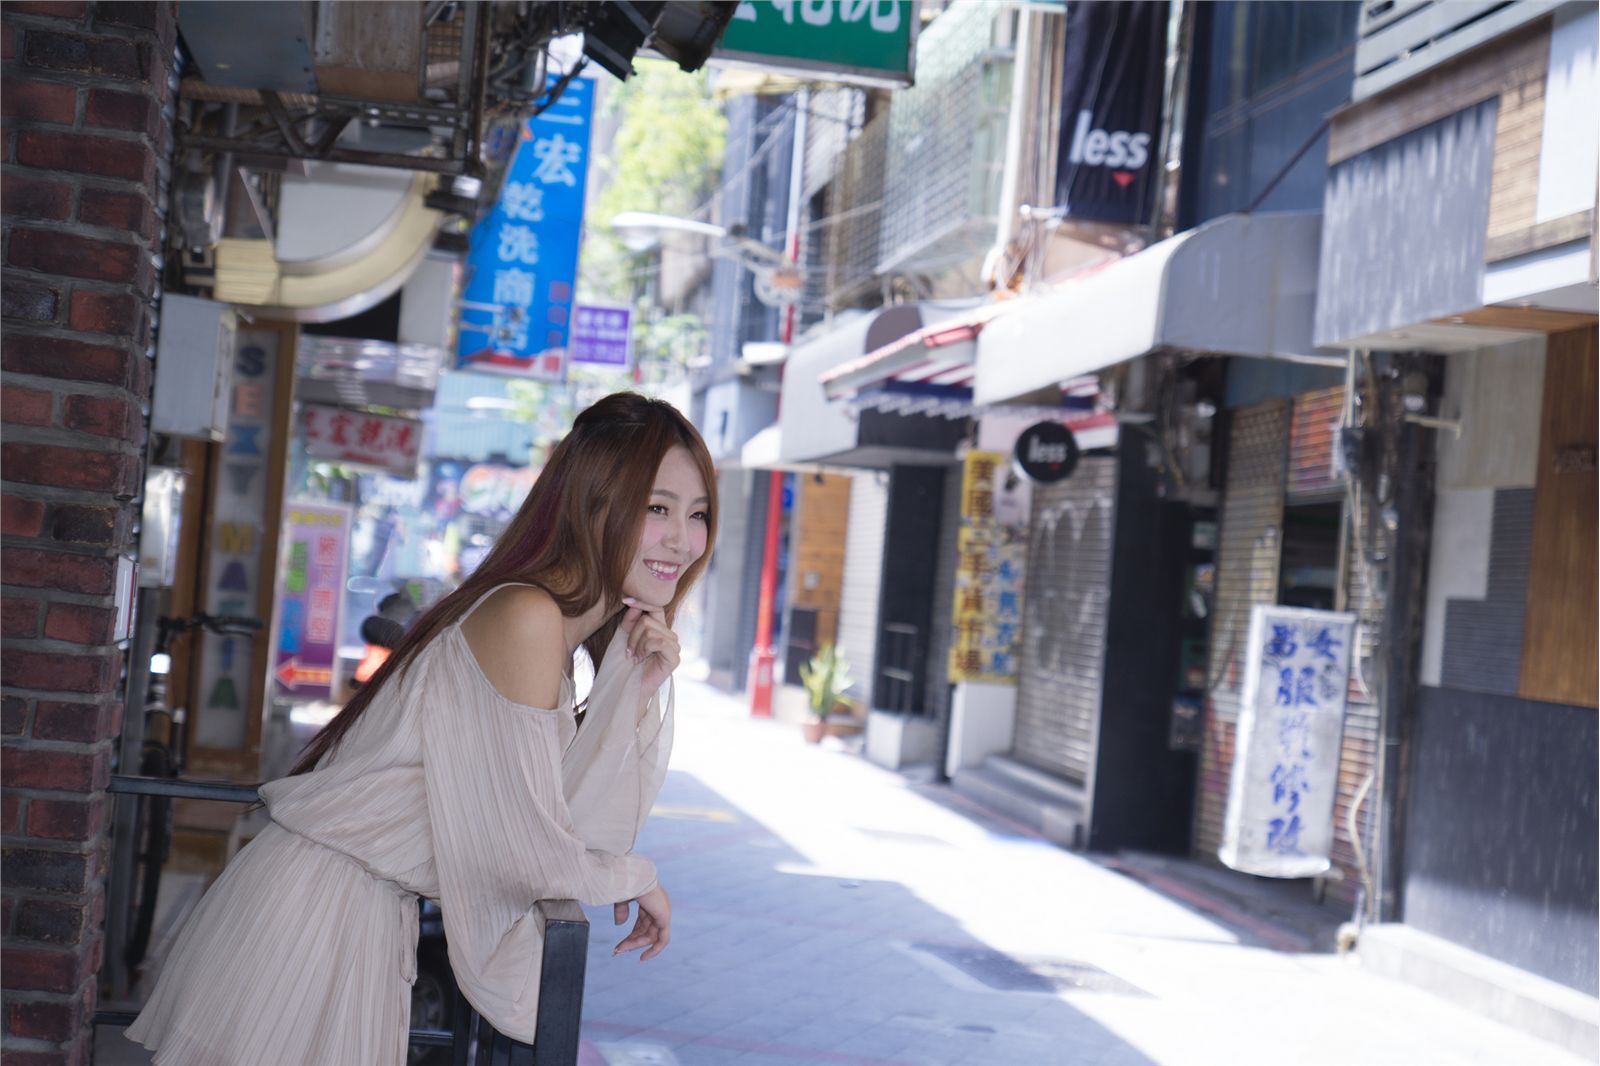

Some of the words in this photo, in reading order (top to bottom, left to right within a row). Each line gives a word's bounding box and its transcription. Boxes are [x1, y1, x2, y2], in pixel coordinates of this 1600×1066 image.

[1069, 109, 1151, 170] less
[225, 345, 267, 498] SEXY
[1029, 434, 1068, 463] less
